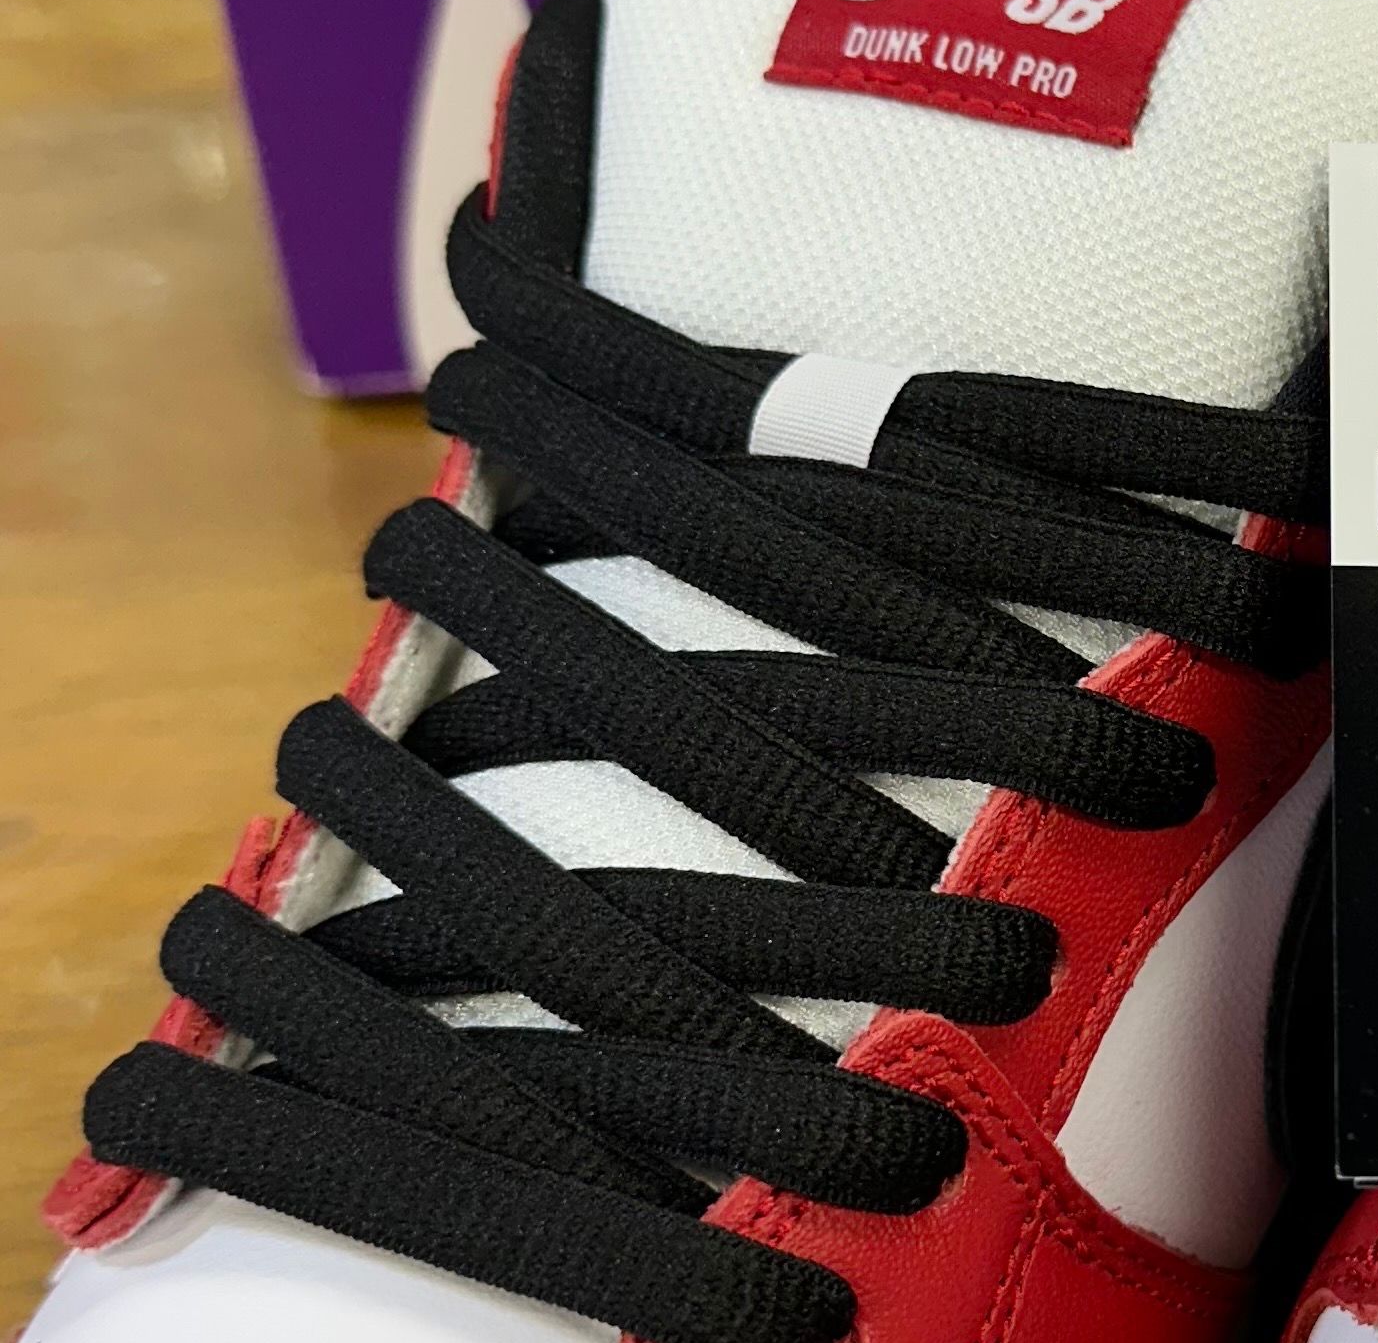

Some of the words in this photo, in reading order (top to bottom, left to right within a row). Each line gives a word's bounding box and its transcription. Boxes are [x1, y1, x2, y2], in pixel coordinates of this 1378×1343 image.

[843, 25, 929, 63] DUNK
[934, 38, 1004, 79] LOW
[1010, 54, 1078, 98] PRO
